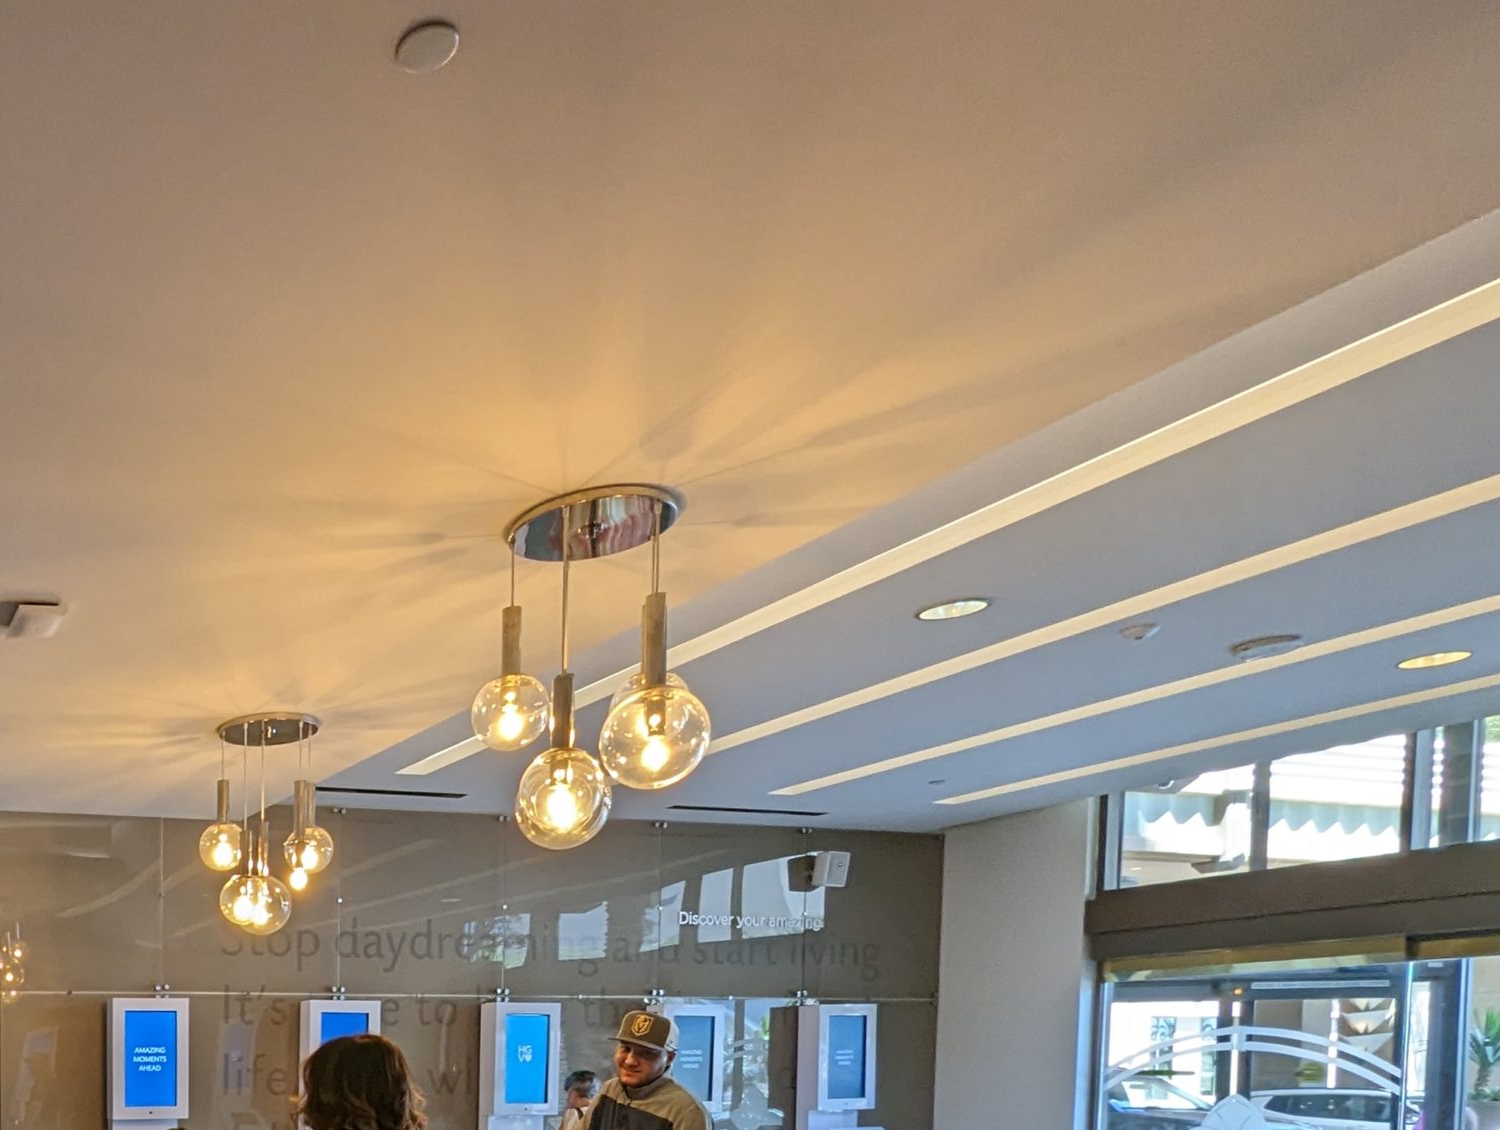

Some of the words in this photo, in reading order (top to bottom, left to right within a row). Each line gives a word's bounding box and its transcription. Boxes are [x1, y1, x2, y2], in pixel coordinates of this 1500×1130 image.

[679, 911, 733, 926] Discover
[736, 915, 766, 929] your
[692, 935, 778, 966] start
[133, 1046, 166, 1054] AMAZING
[132, 1055, 167, 1063] MOMENTS
[138, 1064, 162, 1072] AHEAD
